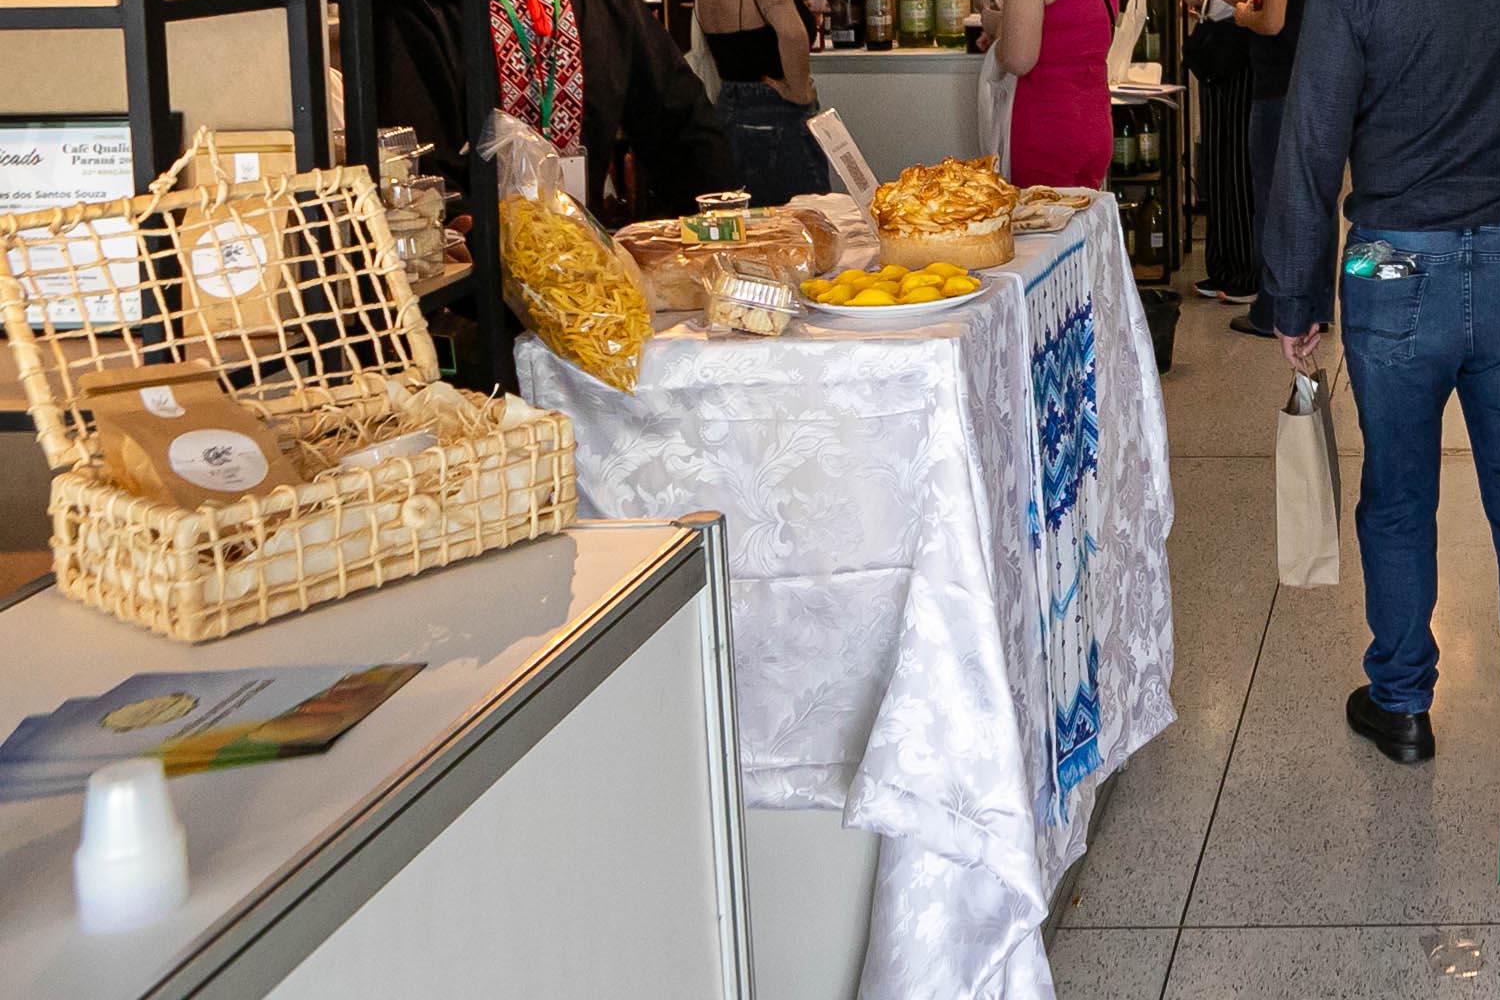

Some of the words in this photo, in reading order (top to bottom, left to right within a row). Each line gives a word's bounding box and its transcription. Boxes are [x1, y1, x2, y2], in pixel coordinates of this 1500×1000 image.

[62, 143, 90, 154] Café
[72, 155, 115, 165] Paraná
[12, 190, 32, 199] dos
[35, 190, 72, 199] Santos
[75, 189, 107, 198] Souza
